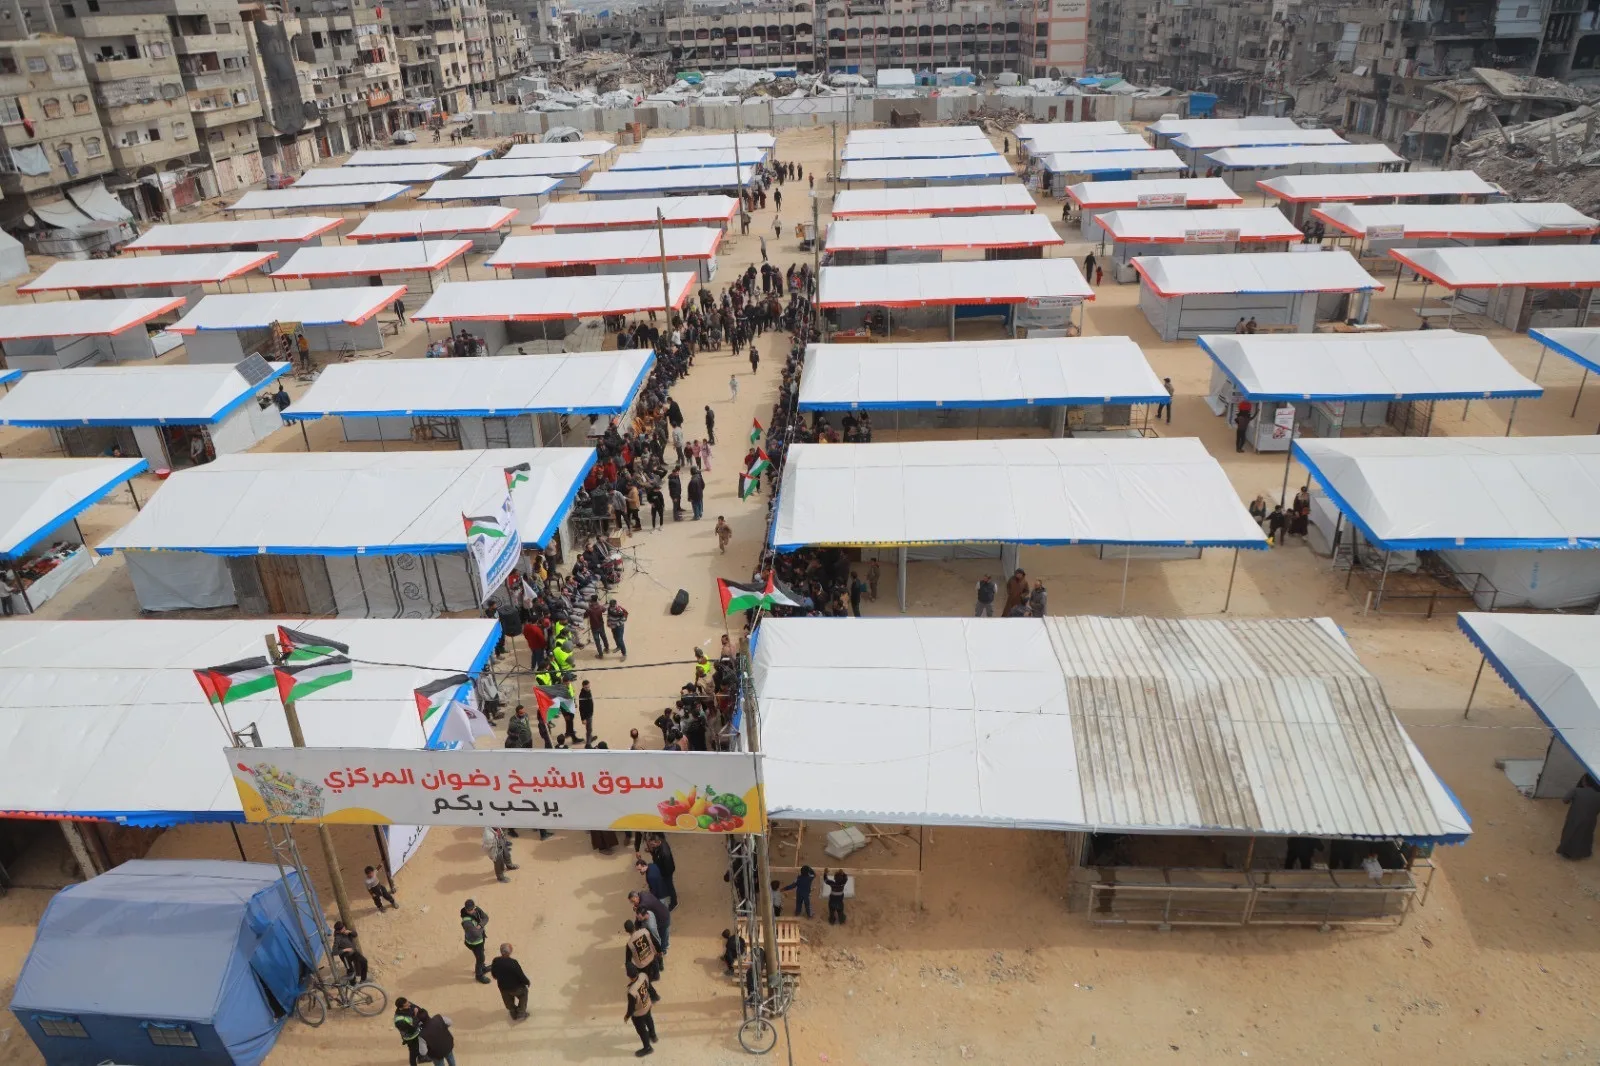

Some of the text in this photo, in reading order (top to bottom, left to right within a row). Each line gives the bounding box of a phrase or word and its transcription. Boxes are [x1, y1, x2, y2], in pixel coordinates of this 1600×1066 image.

[323, 766, 664, 795] سوق الشيخ رضوان المركزي
[431, 794, 563, 818] يرحب بكم
